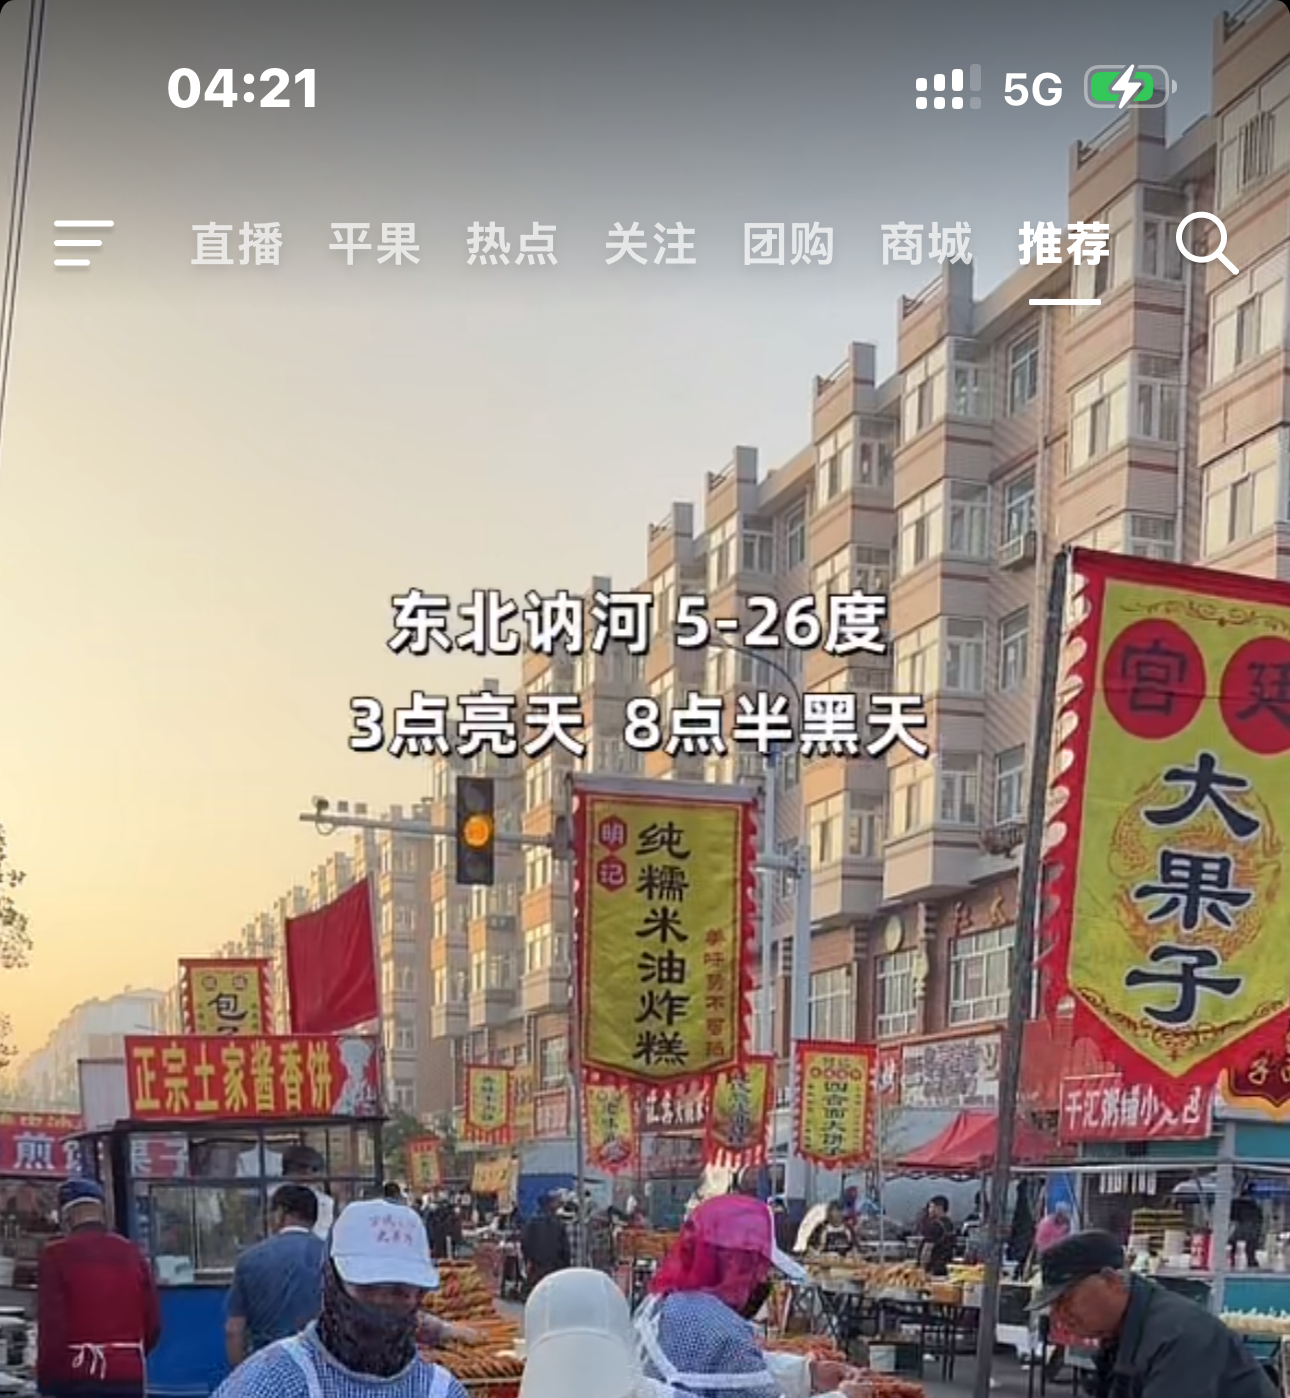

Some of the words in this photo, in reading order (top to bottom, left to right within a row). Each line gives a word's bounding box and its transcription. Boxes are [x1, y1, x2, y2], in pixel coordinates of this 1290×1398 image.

[599, 823, 625, 886] 明记
[1125, 752, 1260, 1028] 大果子
[633, 821, 692, 1066] 纯糯米油炸糕
[132, 1038, 333, 1116] 正宗土家酱香饼
